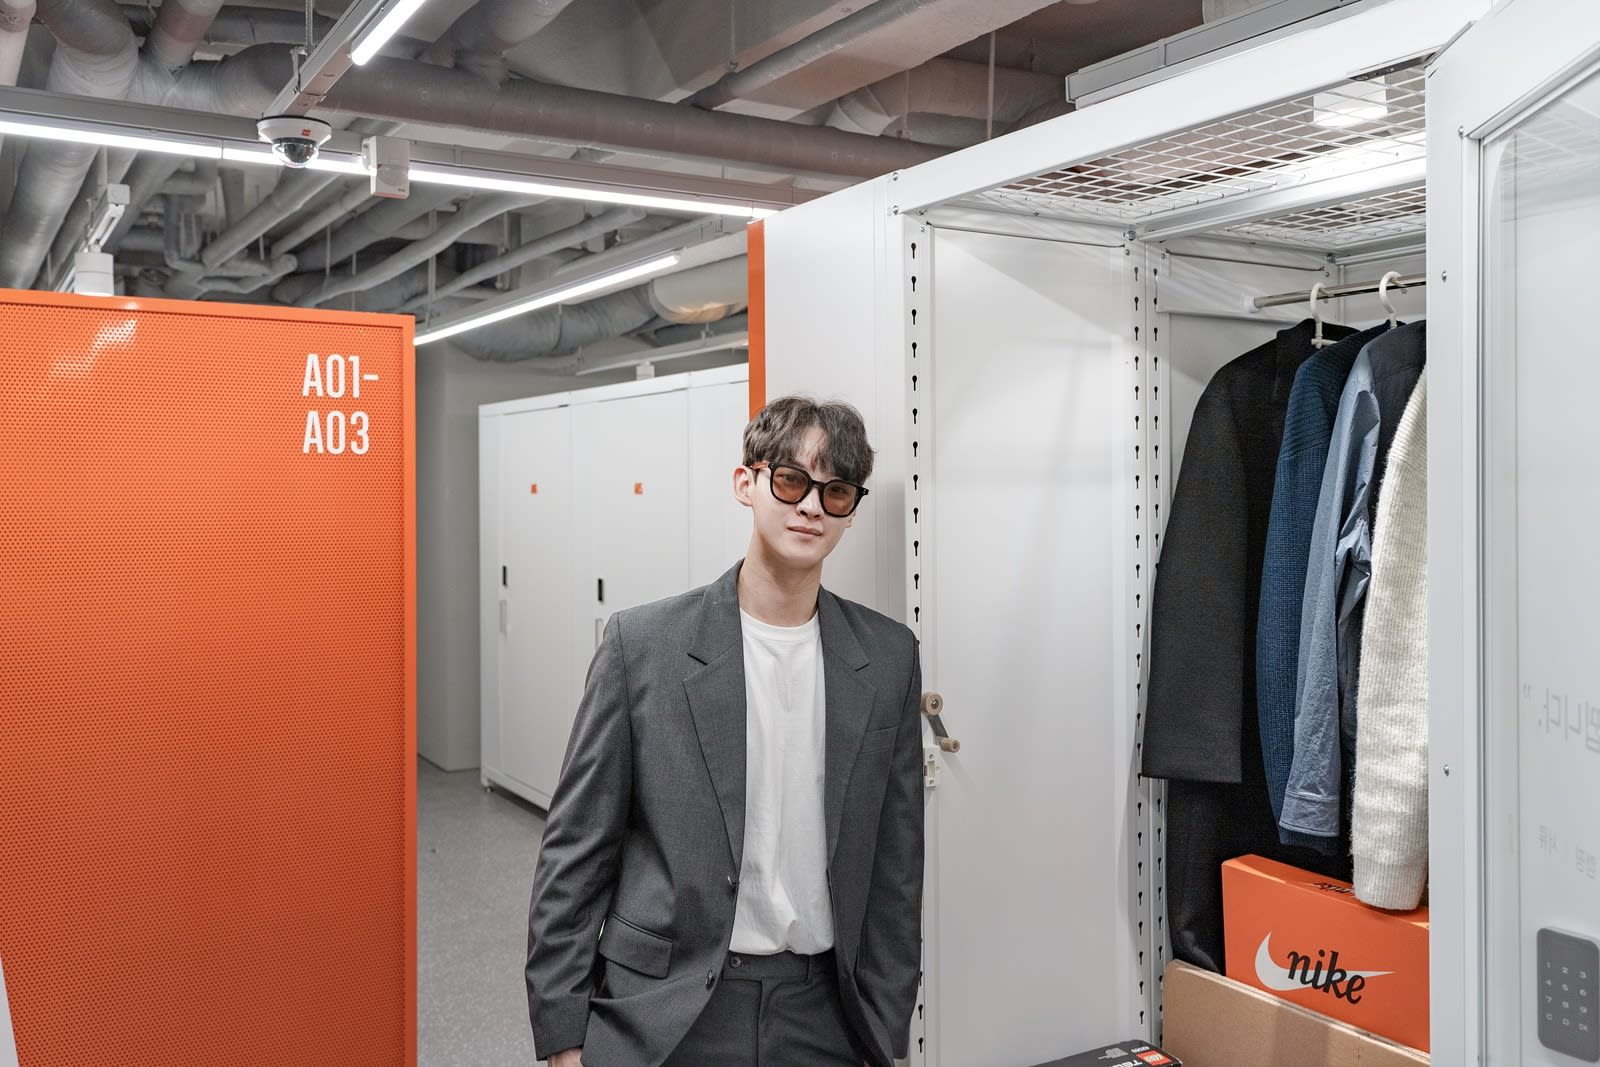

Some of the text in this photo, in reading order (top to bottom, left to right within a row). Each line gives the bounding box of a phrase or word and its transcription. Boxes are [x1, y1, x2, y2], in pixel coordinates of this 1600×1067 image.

[302, 353, 379, 399] A01-
[302, 410, 370, 455] A03
[1287, 949, 1366, 1005] nike
[1544, 979, 1588, 997] 4 5 6
[1561, 966, 1569, 975] 2
[1578, 971, 1587, 980] 3
[1545, 995, 1588, 1014] 7 8 9
